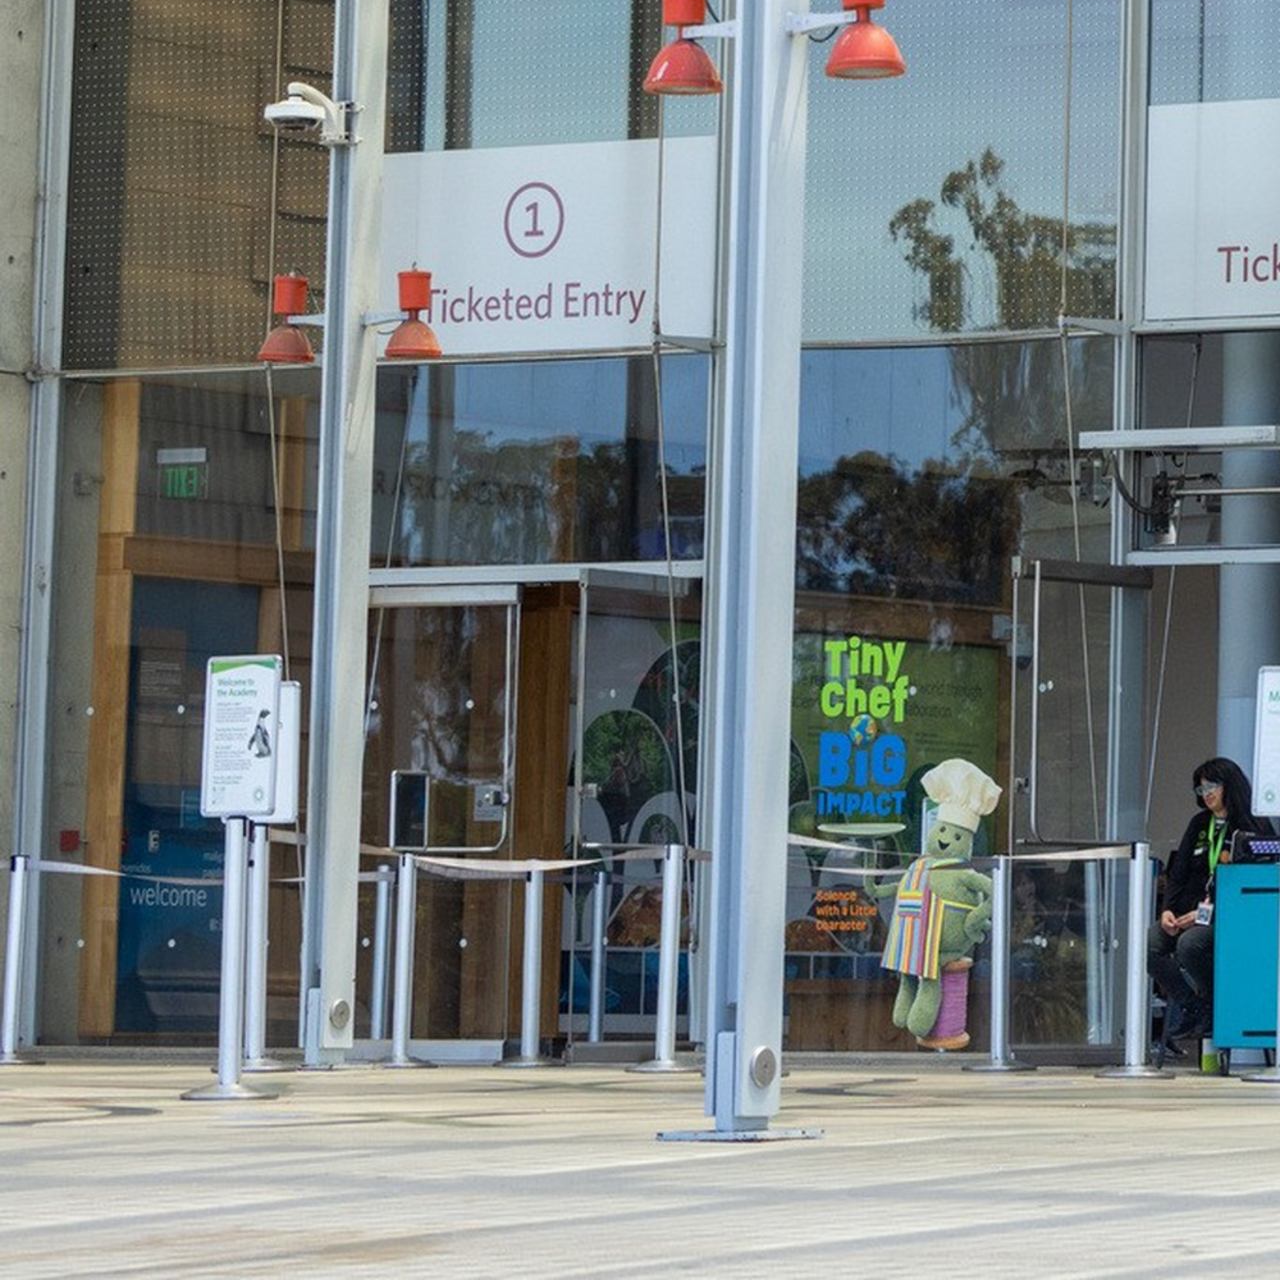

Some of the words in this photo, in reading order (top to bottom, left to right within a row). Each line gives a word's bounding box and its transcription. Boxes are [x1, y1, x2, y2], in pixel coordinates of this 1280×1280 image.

[524, 202, 545, 238] 1
[428, 283, 553, 325] Ticketed
[563, 281, 647, 325] Entry
[824, 636, 906, 683] Tiny
[821, 675, 909, 723] Chef
[817, 789, 907, 816] IMPACT
[130, 882, 207, 907] welcome
[816, 890, 858, 902] Science
[816, 905, 840, 916] with
[850, 905, 877, 916] Little
[815, 920, 867, 931] Character
